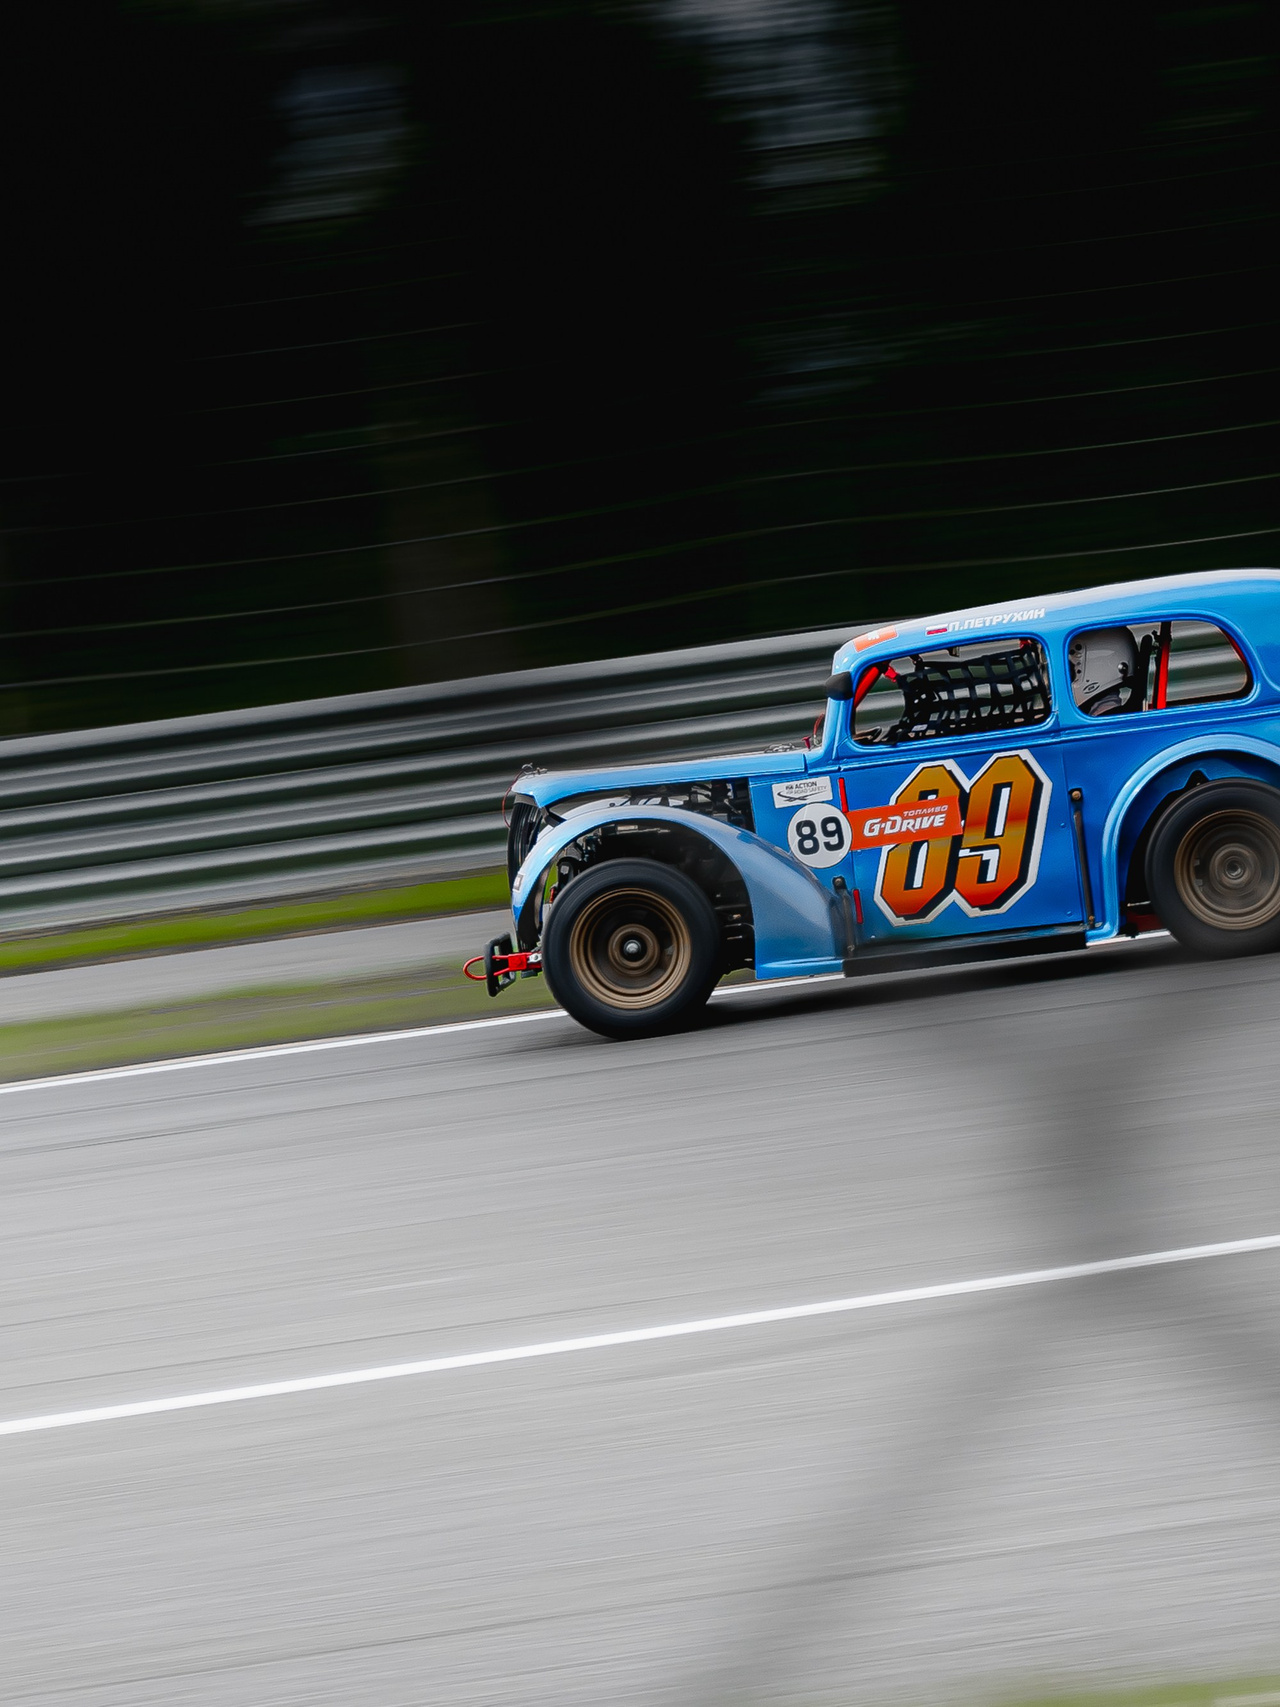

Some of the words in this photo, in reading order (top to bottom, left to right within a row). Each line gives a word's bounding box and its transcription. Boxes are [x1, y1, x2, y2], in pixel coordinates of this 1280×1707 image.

[947, 608, 1045, 632] П.ПЕТРУХИН
[794, 781, 818, 789] ACTION
[903, 804, 949, 817] ТОПЛИВО
[795, 815, 845, 856] 89
[874, 749, 1053, 928] 89
